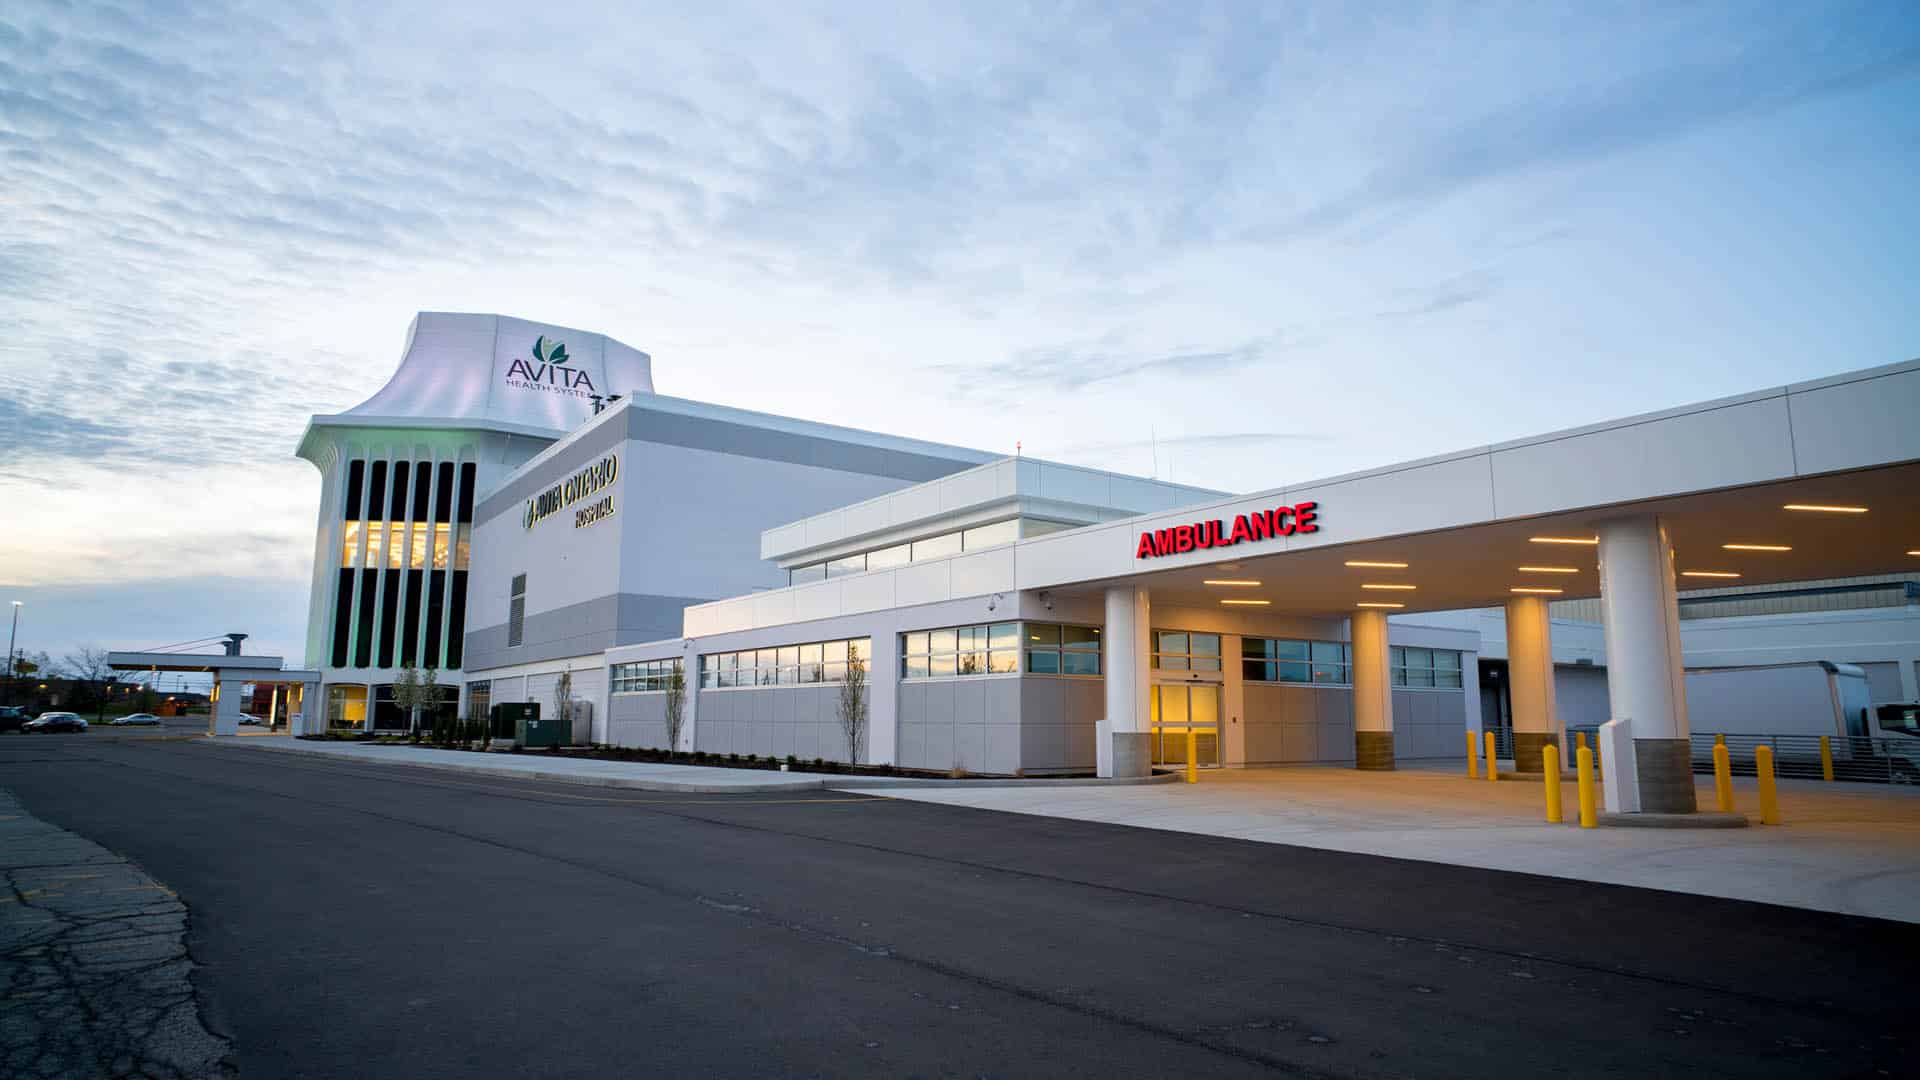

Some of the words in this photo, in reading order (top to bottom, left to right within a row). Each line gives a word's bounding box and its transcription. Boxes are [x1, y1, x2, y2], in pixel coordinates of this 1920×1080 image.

[506, 379, 550, 391] HEALTH
[507, 359, 594, 391] AVITA
[565, 454, 618, 505] ONTARIO
[575, 495, 616, 528] HOSPITAL
[1136, 502, 1319, 559] AMBULANCE
